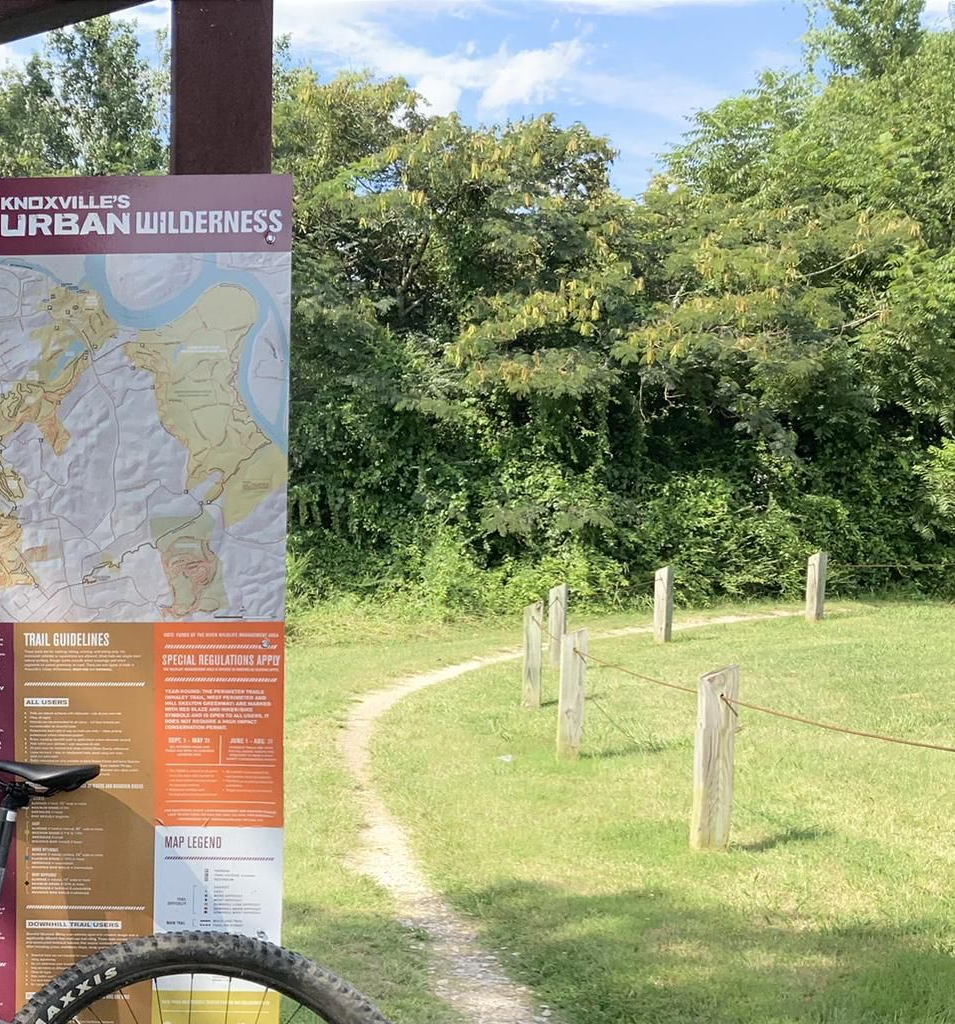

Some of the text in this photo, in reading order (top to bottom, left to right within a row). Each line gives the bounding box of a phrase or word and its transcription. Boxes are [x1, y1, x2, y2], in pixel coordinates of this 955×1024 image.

[0, 195, 131, 211] KNOXVILLE'S
[0, 208, 284, 237] URBAN WILDERNESS
[24, 632, 110, 646] TRAIL GUIDELINES
[162, 654, 280, 666] SPECIAL REGULATIONS APPLY
[165, 836, 222, 848] MAP LEGEND
